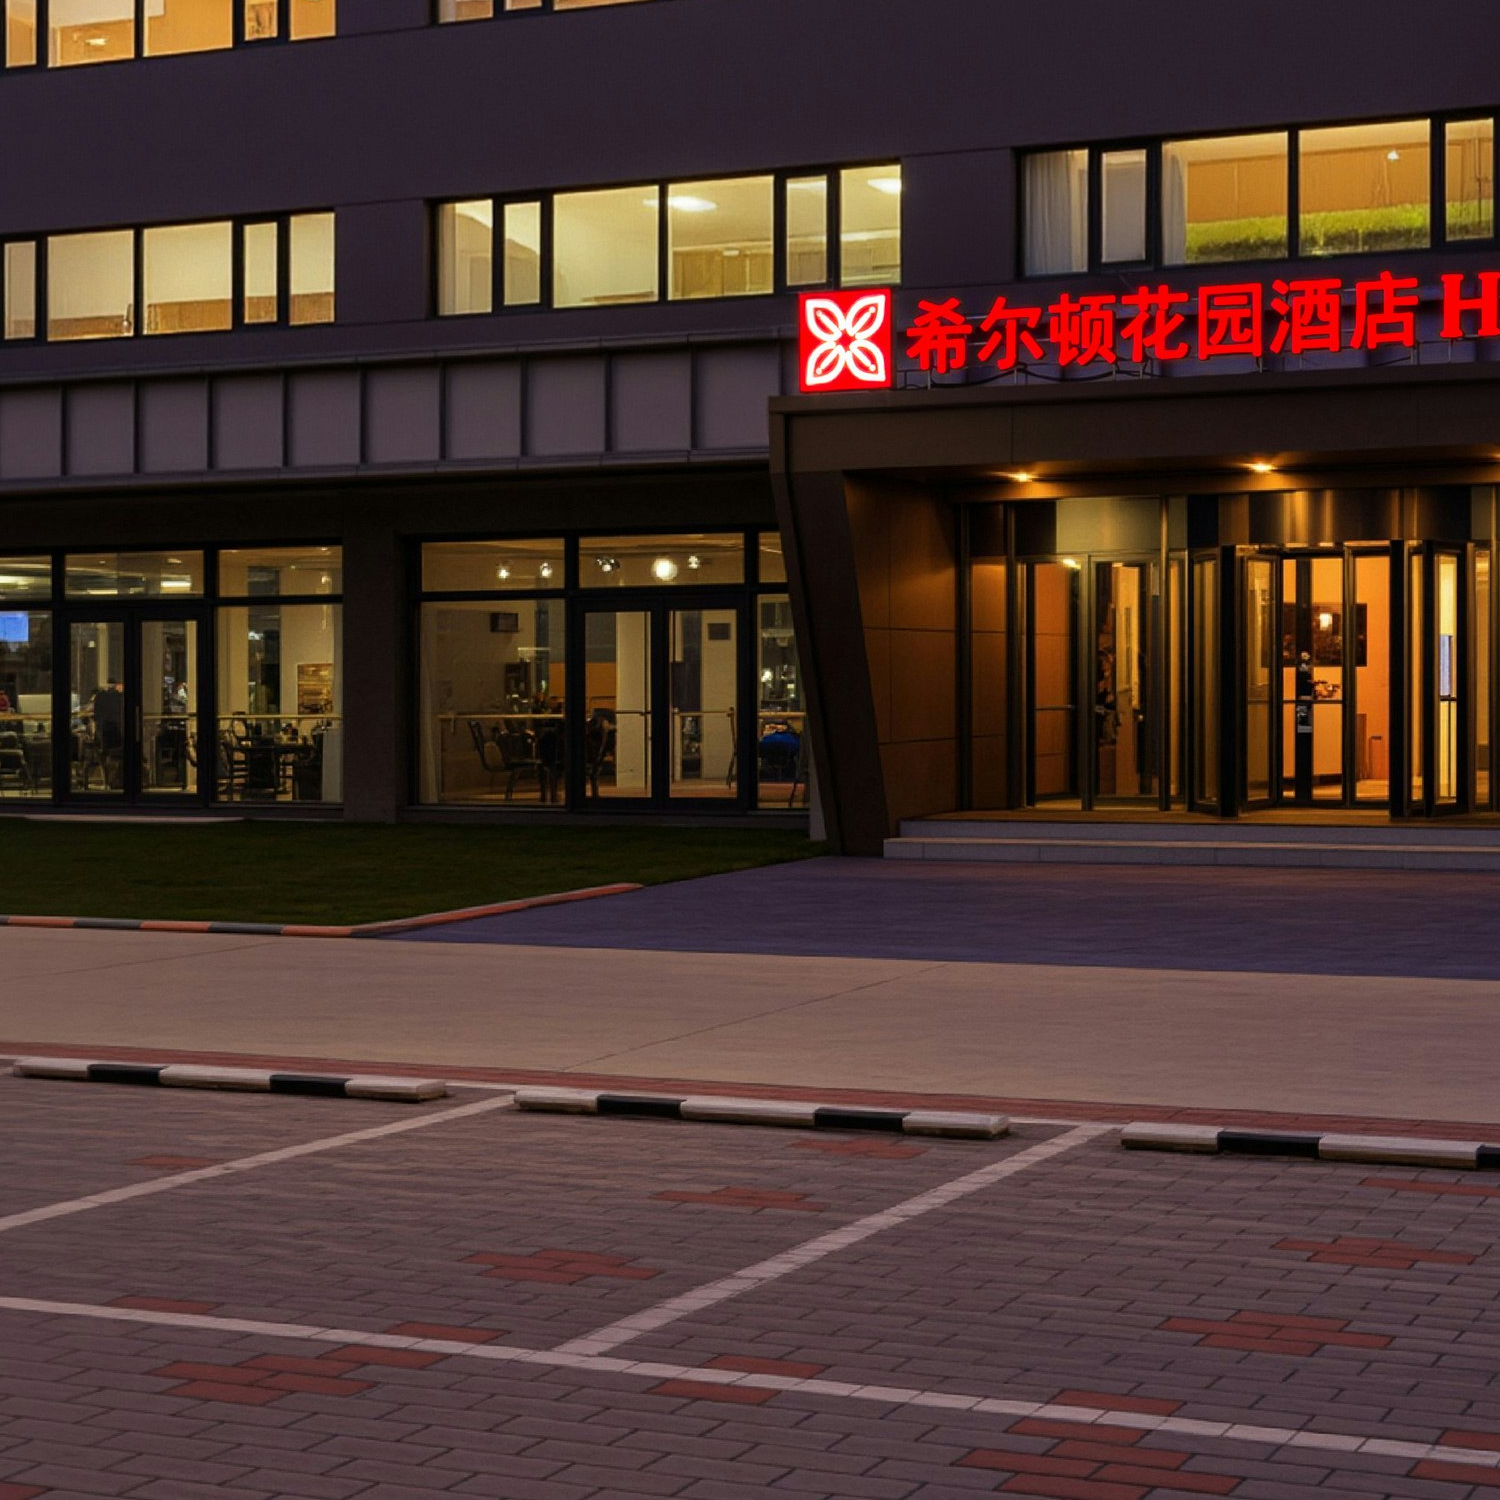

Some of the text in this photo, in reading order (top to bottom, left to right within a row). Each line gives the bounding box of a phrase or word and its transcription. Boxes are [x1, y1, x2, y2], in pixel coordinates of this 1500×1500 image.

[905, 270, 1420, 374] 希尔顿花园酒店
